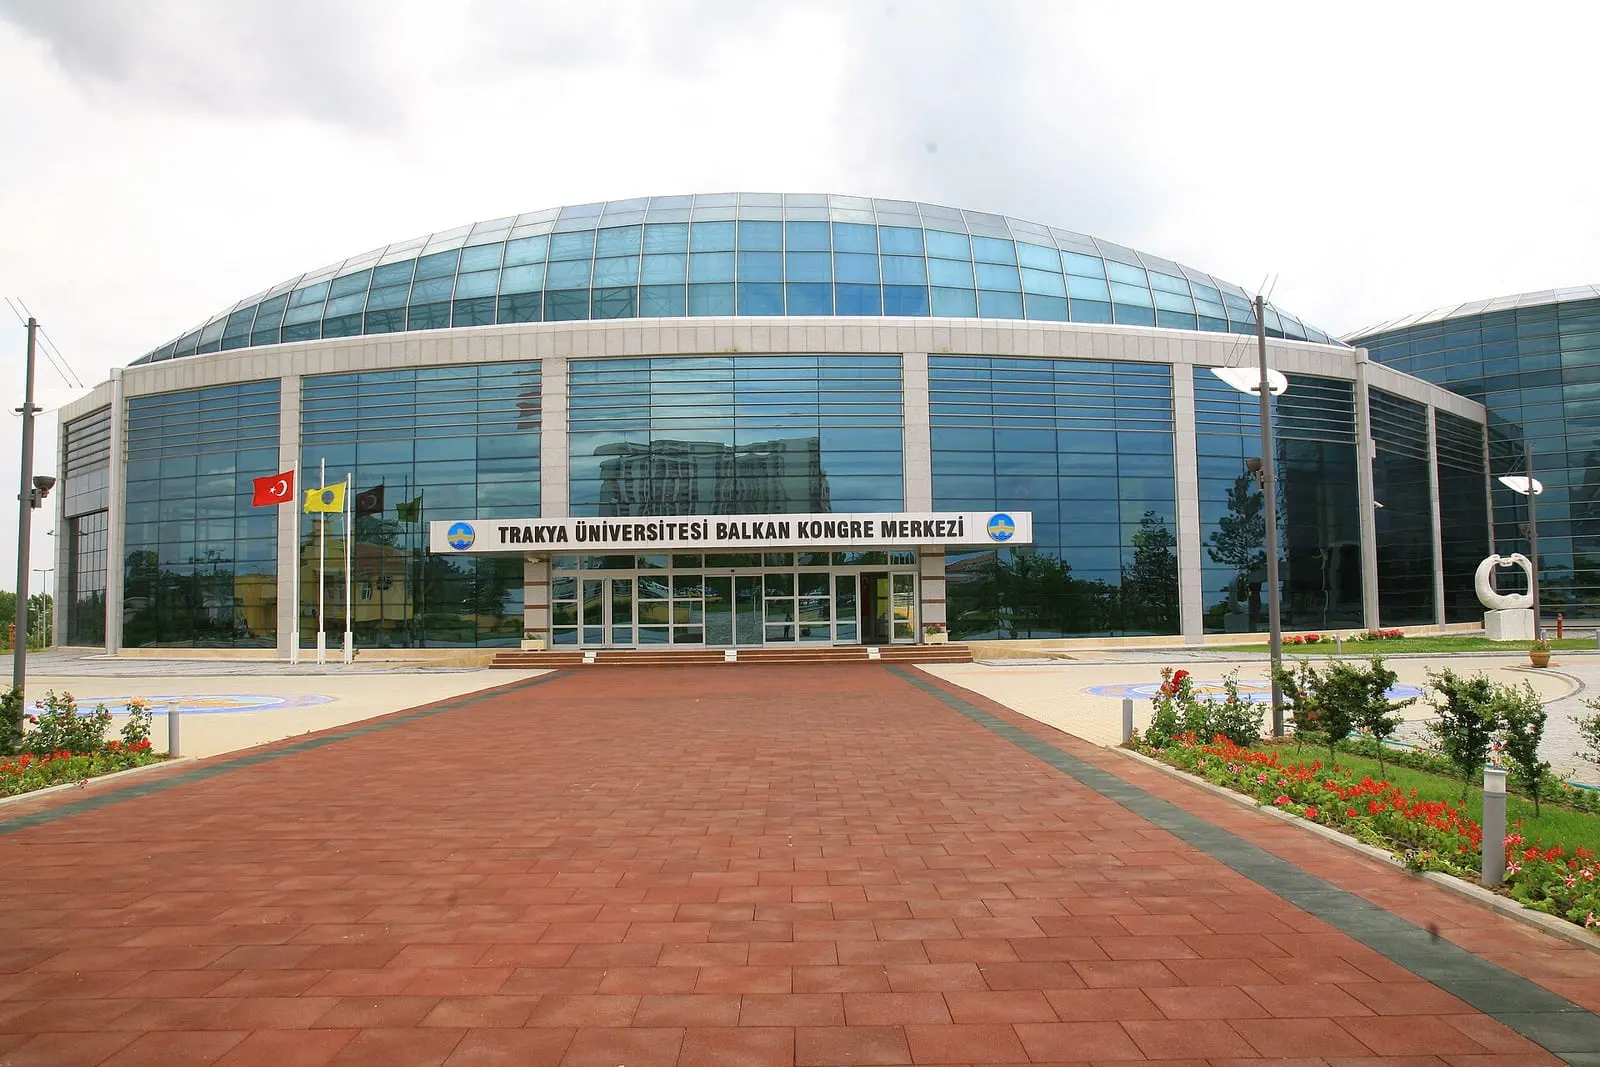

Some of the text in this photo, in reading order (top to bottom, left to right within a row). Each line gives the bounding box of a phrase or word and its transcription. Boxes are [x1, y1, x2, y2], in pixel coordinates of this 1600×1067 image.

[498, 516, 963, 543] TRAKYA ÜNİVERSİTESİ BALKAN KONGRE MERKEZİ
